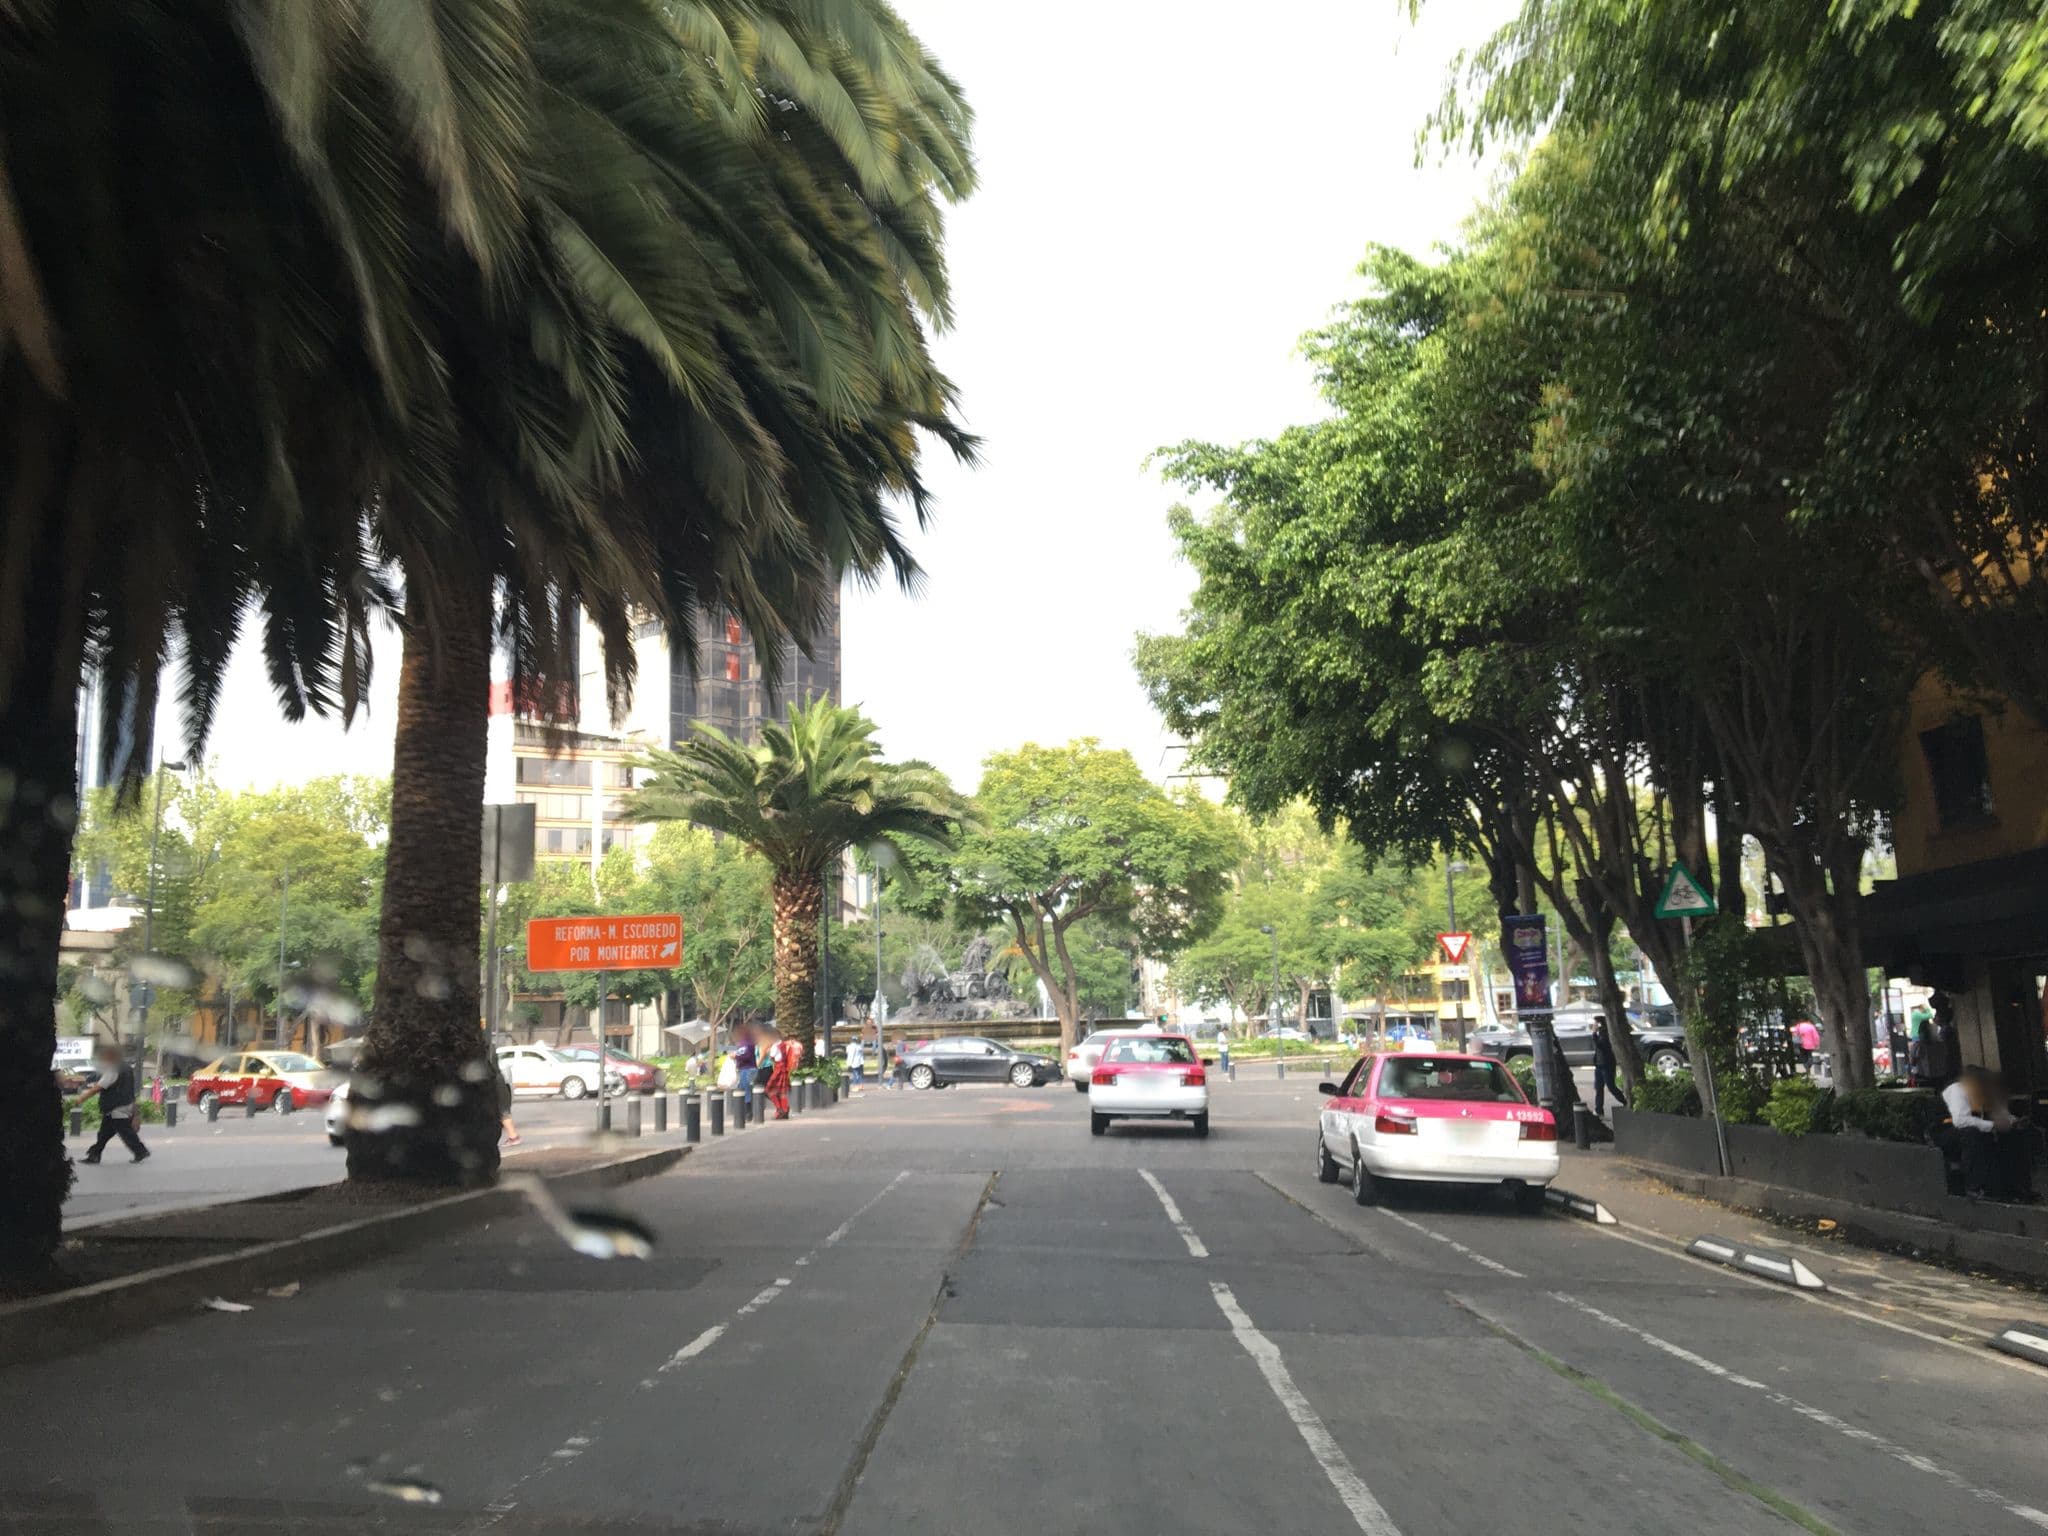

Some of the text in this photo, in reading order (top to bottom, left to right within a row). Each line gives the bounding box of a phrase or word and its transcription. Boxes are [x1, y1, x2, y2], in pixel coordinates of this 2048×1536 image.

[623, 922, 676, 939] ESCOBEDO
[569, 944, 658, 962] POR MONTERREY
[1506, 1109, 1514, 1121] A
